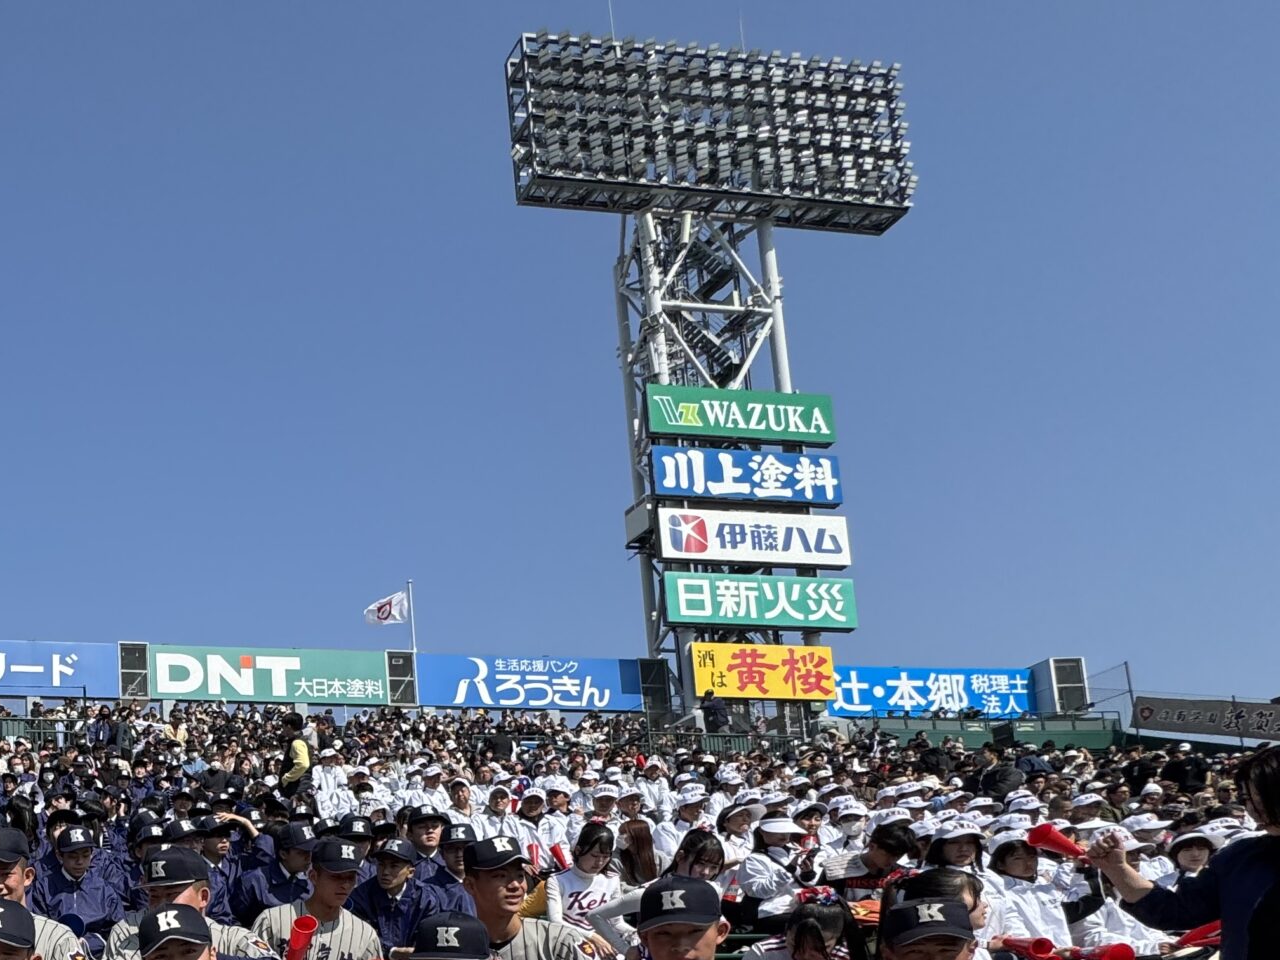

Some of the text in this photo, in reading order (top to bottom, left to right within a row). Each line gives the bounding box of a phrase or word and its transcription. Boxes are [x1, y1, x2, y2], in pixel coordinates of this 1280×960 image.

[701, 400, 830, 434] WAZUKA
[662, 450, 838, 500] 川上塗料
[715, 522, 843, 555] 伊藤ハム
[676, 577, 847, 622] 日新火災
[155, 652, 301, 697] DNT
[494, 658, 579, 674] 生活応援バンク
[727, 648, 833, 696] 黄桜
[294, 677, 385, 698] 大日本塗料
[495, 674, 610, 707] ろうきん
[832, 670, 969, 712] 辻・本郷
[970, 673, 1028, 694] 税理士
[981, 694, 1023, 714] 法人
[70, 829, 85, 842] K
[492, 837, 513, 852] K
[342, 845, 355, 859] K
[152, 861, 166, 877] K
[661, 890, 686, 909] K
[157, 910, 180, 931] K
[917, 904, 945, 922] K
[437, 927, 460, 947] K
